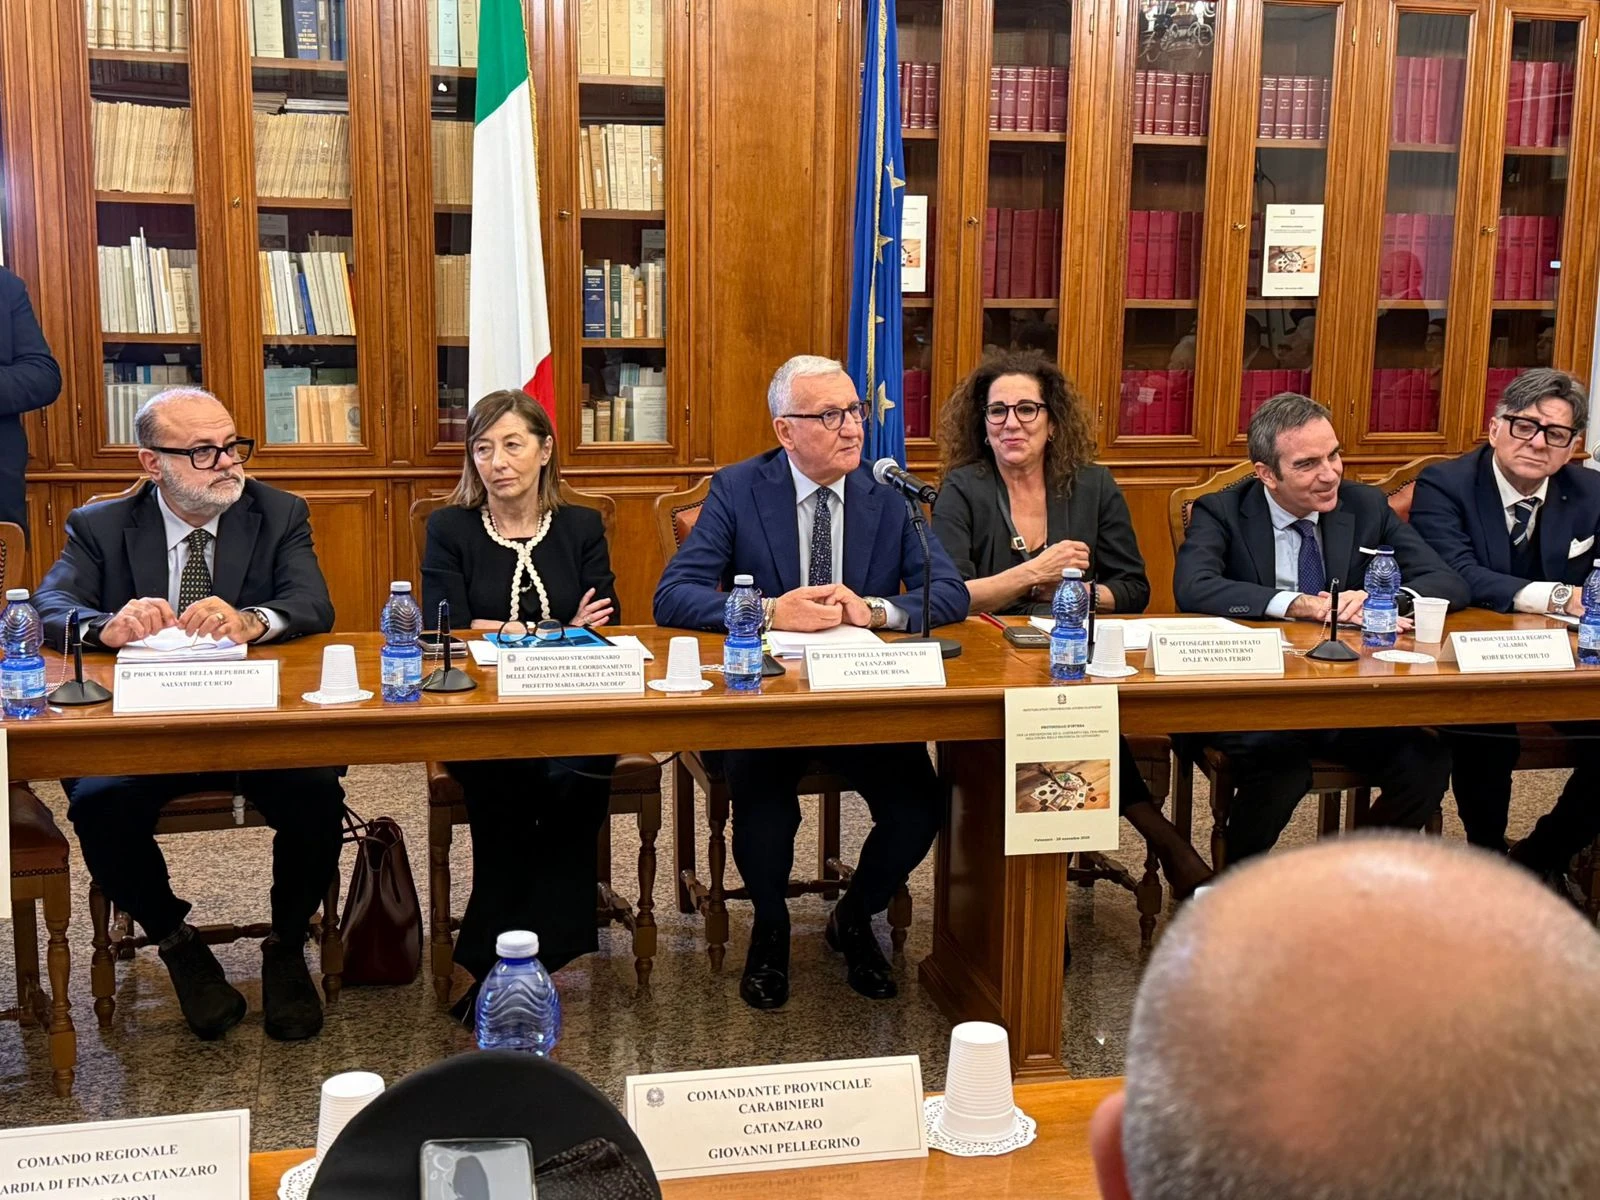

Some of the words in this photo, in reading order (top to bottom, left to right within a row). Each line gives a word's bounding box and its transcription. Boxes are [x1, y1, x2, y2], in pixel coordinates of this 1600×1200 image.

[1514, 652, 1550, 660] OCCHIUTO
[133, 670, 187, 678] PROCURATORE
[214, 668, 260, 676] REPUBBLICA
[161, 680, 202, 688] SALVATORE
[686, 1084, 781, 1103] COMANDANTE
[784, 1077, 873, 1096] PROVINCIALE
[738, 1097, 824, 1114] CARABINIERI
[743, 1118, 823, 1135] CATANZARO
[16, 1152, 92, 1170] COMANDO
[95, 1143, 178, 1162] REGIONALE
[708, 1144, 773, 1161] GIOVANNI
[776, 1136, 861, 1154] PELLEGRINO
[49, 1179, 63, 1190] DI
[67, 1173, 129, 1189] FINANZA
[132, 1163, 218, 1182] CATANZARO
